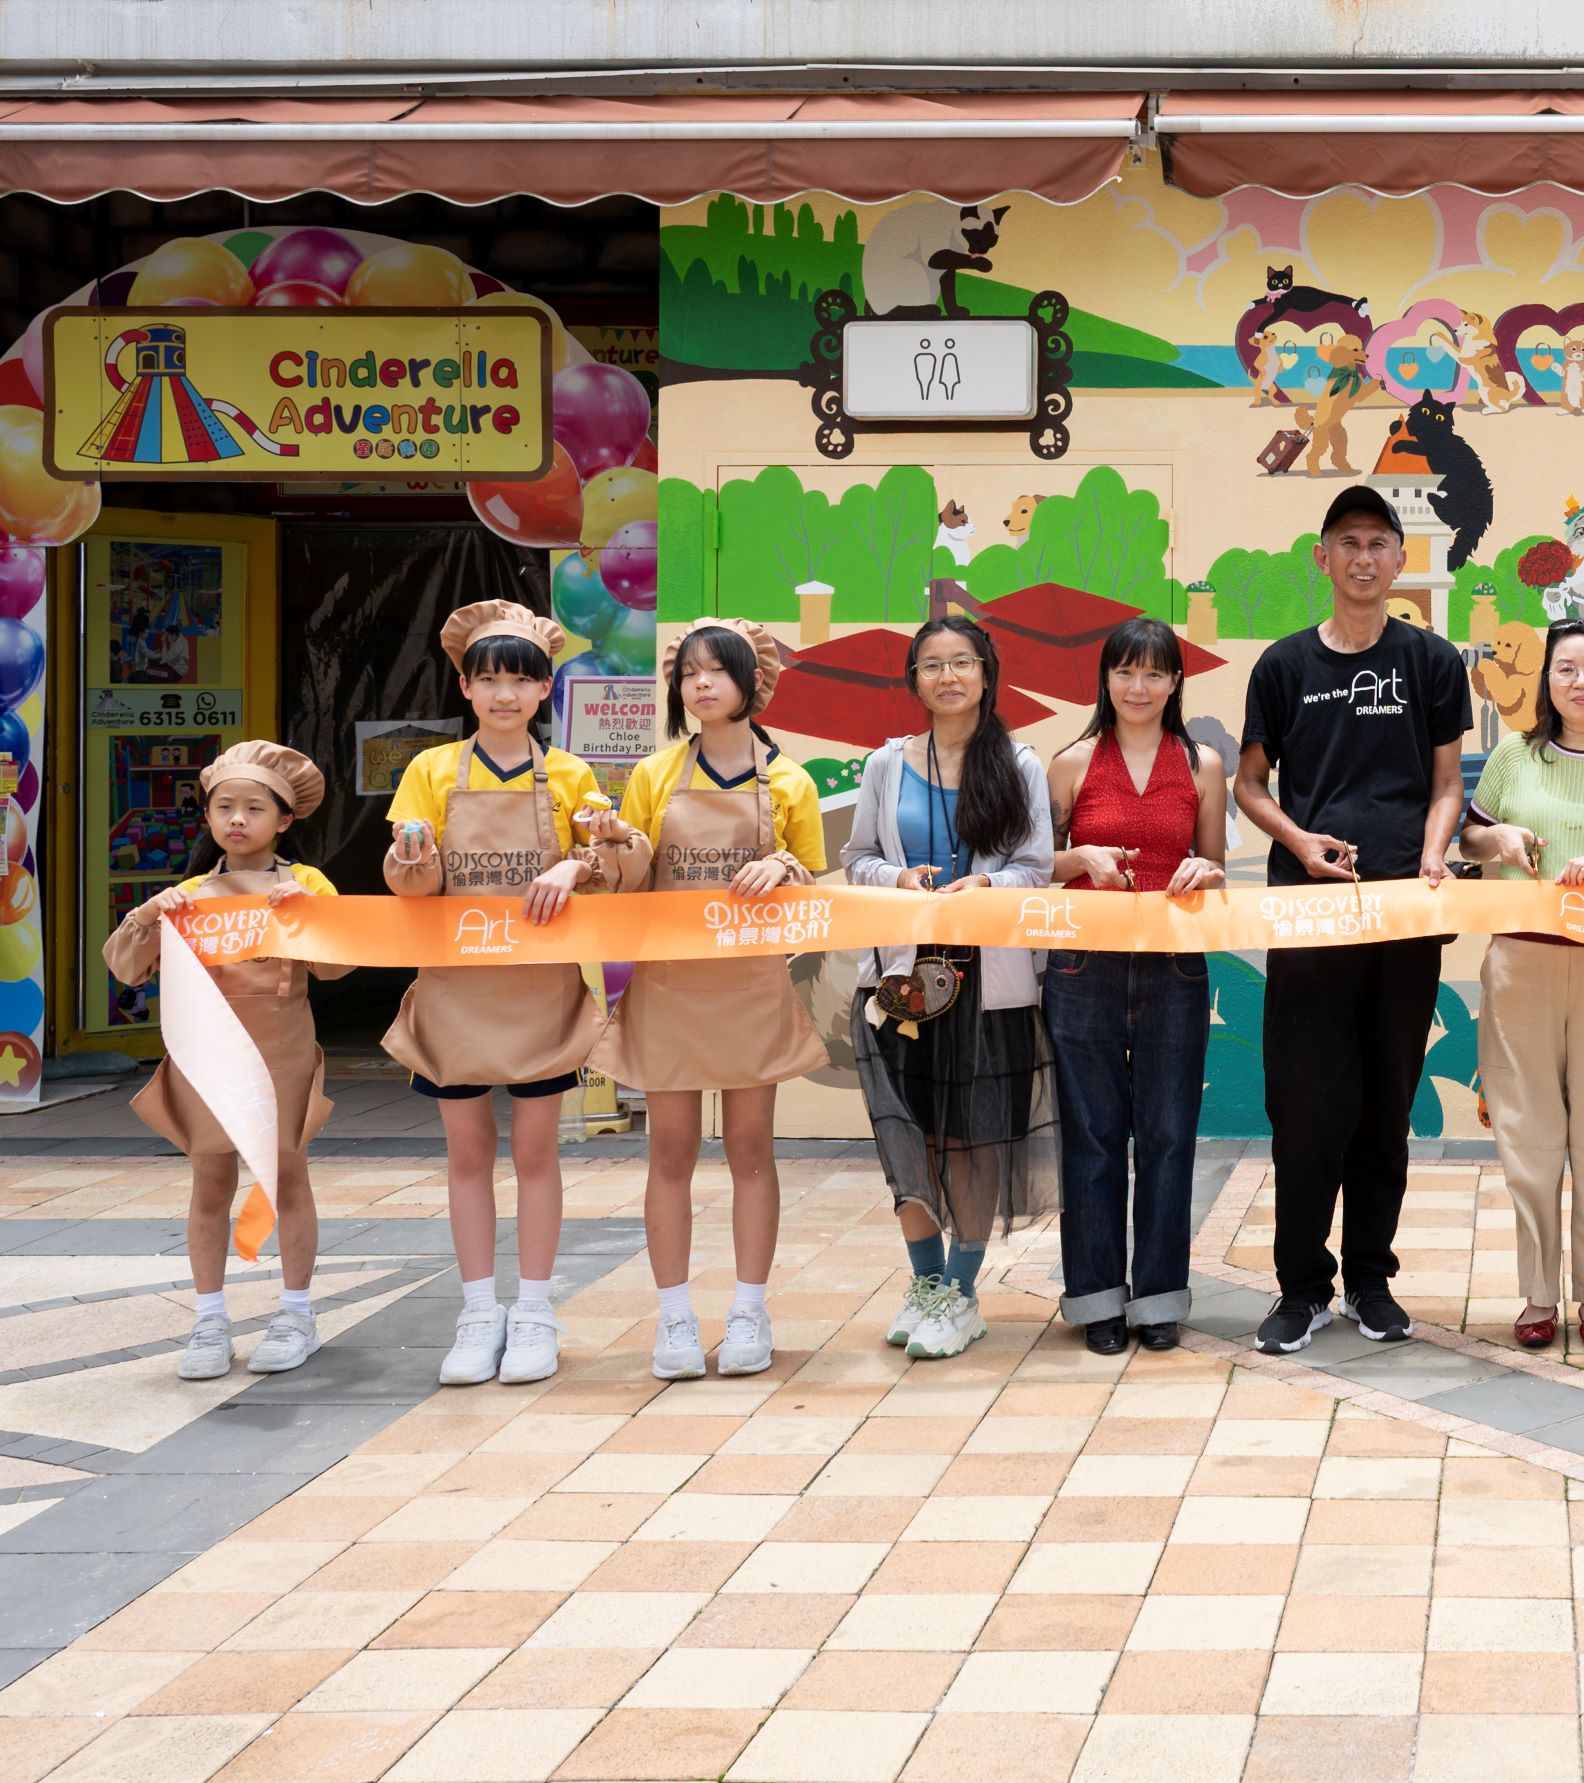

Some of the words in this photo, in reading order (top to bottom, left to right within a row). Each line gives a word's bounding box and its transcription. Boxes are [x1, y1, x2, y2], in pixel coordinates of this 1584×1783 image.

[592, 345, 659, 364] nture
[269, 350, 518, 388] Cinderella
[268, 397, 521, 434] Adventure
[1303, 692, 1331, 704] We're
[1332, 688, 1349, 699] the
[1348, 668, 1408, 706] Art
[139, 711, 186, 726] 6315
[193, 711, 236, 726] 0611
[1356, 705, 1403, 715] DREAMERS
[598, 718, 652, 730] 熱烈歡迎
[609, 732, 640, 741] Chloe
[583, 743, 632, 754] Birthday
[634, 743, 656, 752] Par
[448, 850, 544, 872] DISCOVERY
[453, 870, 503, 887] 愉景灣
[672, 866, 719, 881] 愉景灣
[703, 898, 834, 930] DISCOVERY
[1017, 896, 1082, 929] Art
[1259, 894, 1384, 920] DISCOVERY
[174, 908, 274, 938] ISCOVERY
[454, 909, 519, 945] Art
[783, 919, 833, 944] BAY
[1025, 928, 1077, 938] DREAMERS
[1272, 917, 1335, 937] 愉景灣
[1338, 912, 1384, 935] BAY
[221, 928, 269, 954] BAY
[716, 927, 781, 947] 愉景灣
[460, 944, 513, 954] DREAMERS
